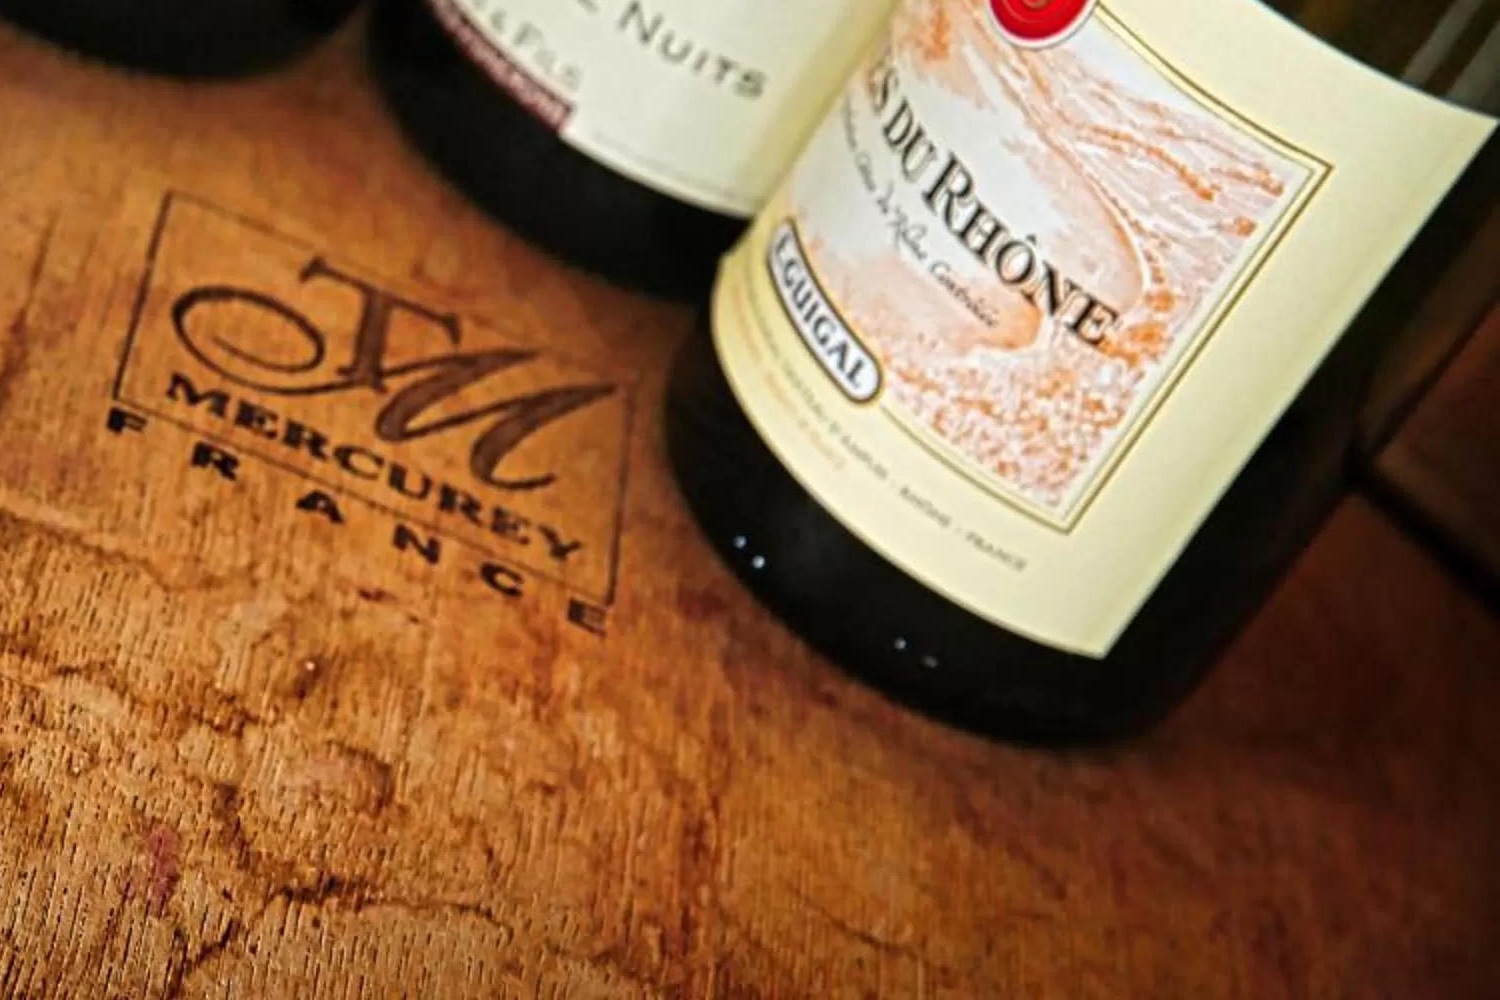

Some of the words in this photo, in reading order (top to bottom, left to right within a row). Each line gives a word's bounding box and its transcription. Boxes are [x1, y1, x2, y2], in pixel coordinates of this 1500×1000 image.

[883, 96, 938, 183] DU
[921, 151, 1120, 346] RHÔNE
[107, 407, 607, 638] FRANCE
[166, 372, 582, 563] MERCUREY
